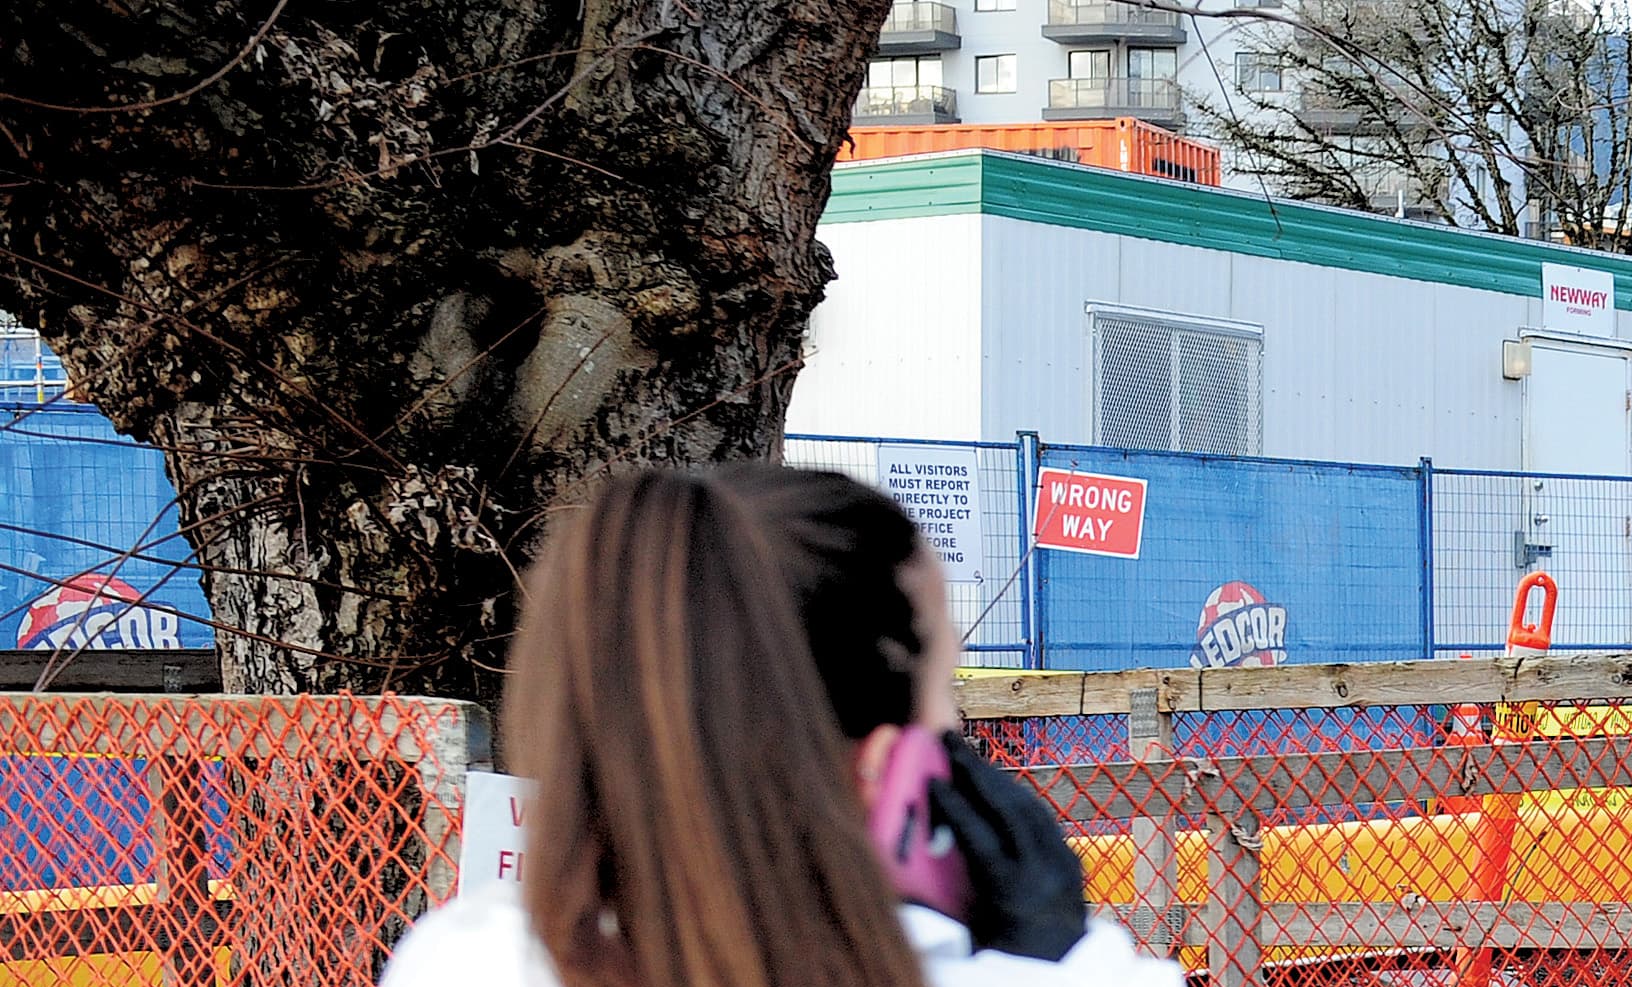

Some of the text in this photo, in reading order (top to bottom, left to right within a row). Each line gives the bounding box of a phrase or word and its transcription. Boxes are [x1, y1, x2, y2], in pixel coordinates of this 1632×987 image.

[1550, 284, 1608, 310] NEWWAY
[890, 464, 968, 476] ALL VISITORS
[889, 478, 970, 491] MUST REPORT
[953, 494, 968, 505] TO
[1051, 481, 1132, 513] WRONG
[919, 508, 971, 520] PROJECT
[1063, 513, 1114, 542] WAY
